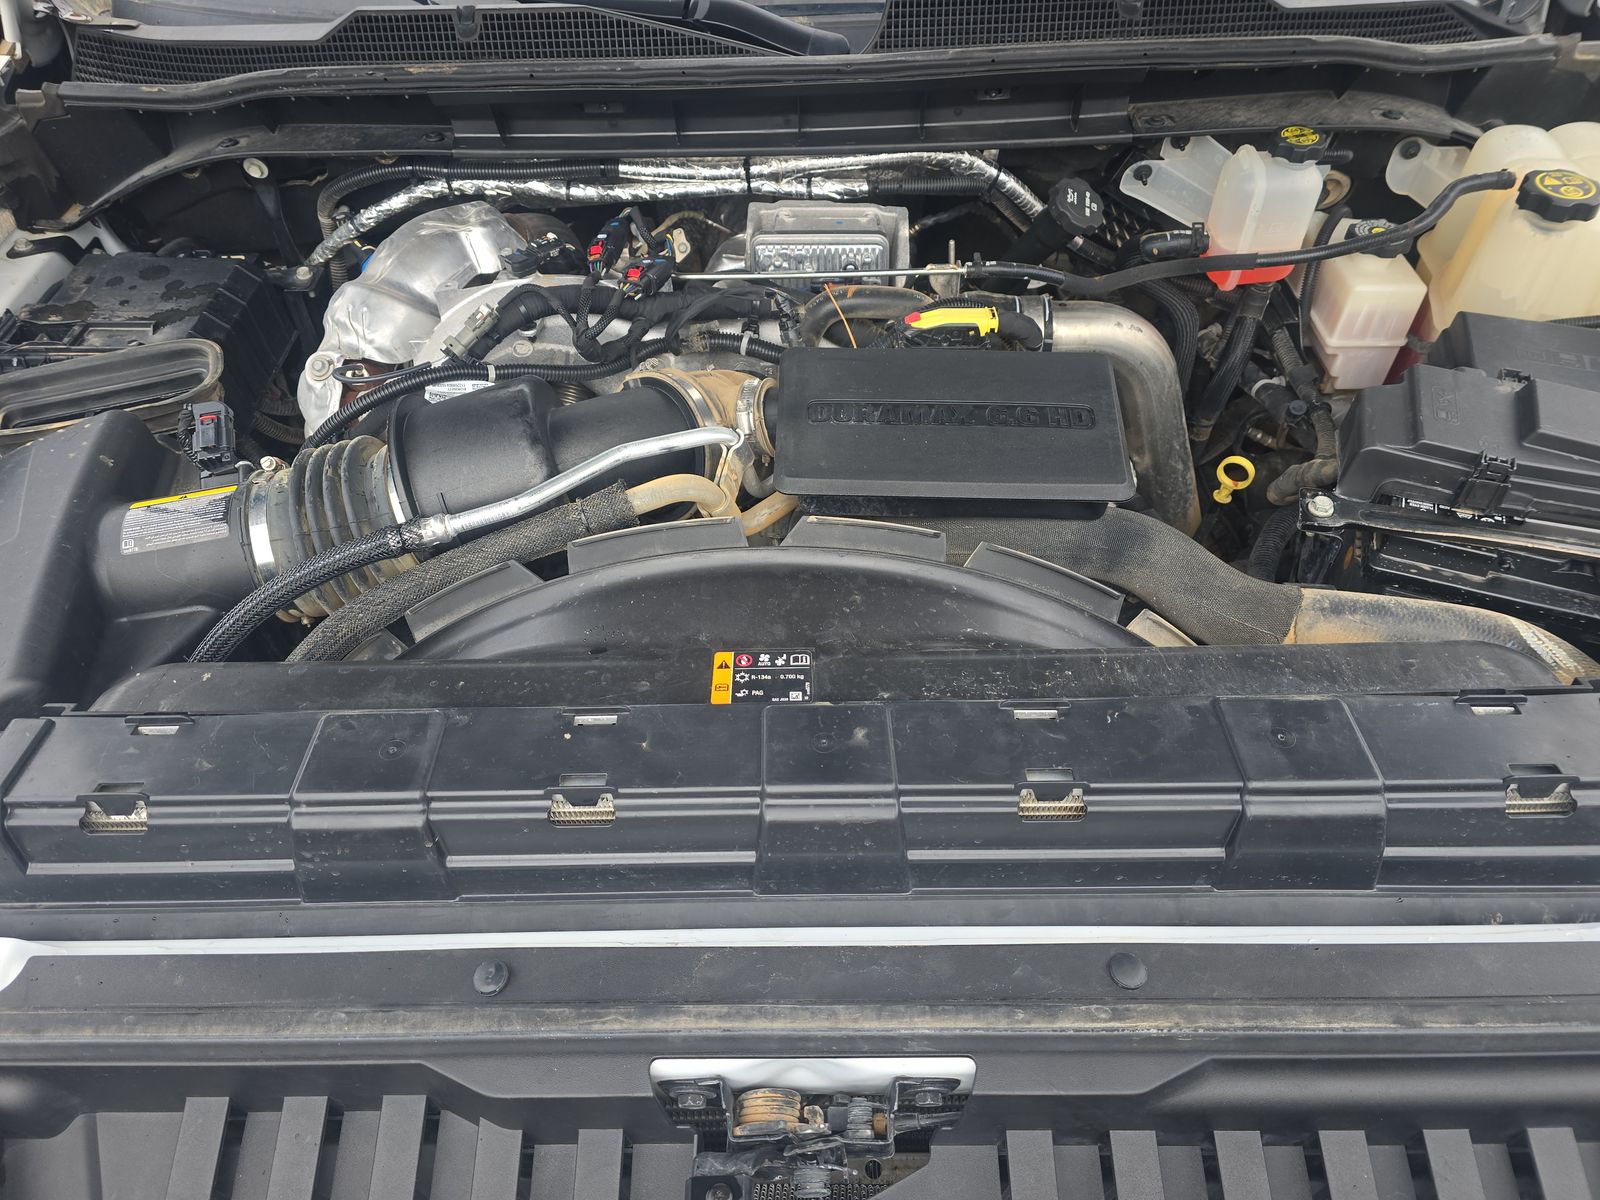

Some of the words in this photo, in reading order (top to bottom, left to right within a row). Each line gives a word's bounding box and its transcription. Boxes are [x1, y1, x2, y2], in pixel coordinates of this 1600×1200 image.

[808, 403, 976, 426] DURAMAX
[985, 405, 1041, 427] 6.6
[1047, 406, 1093, 429] HD
